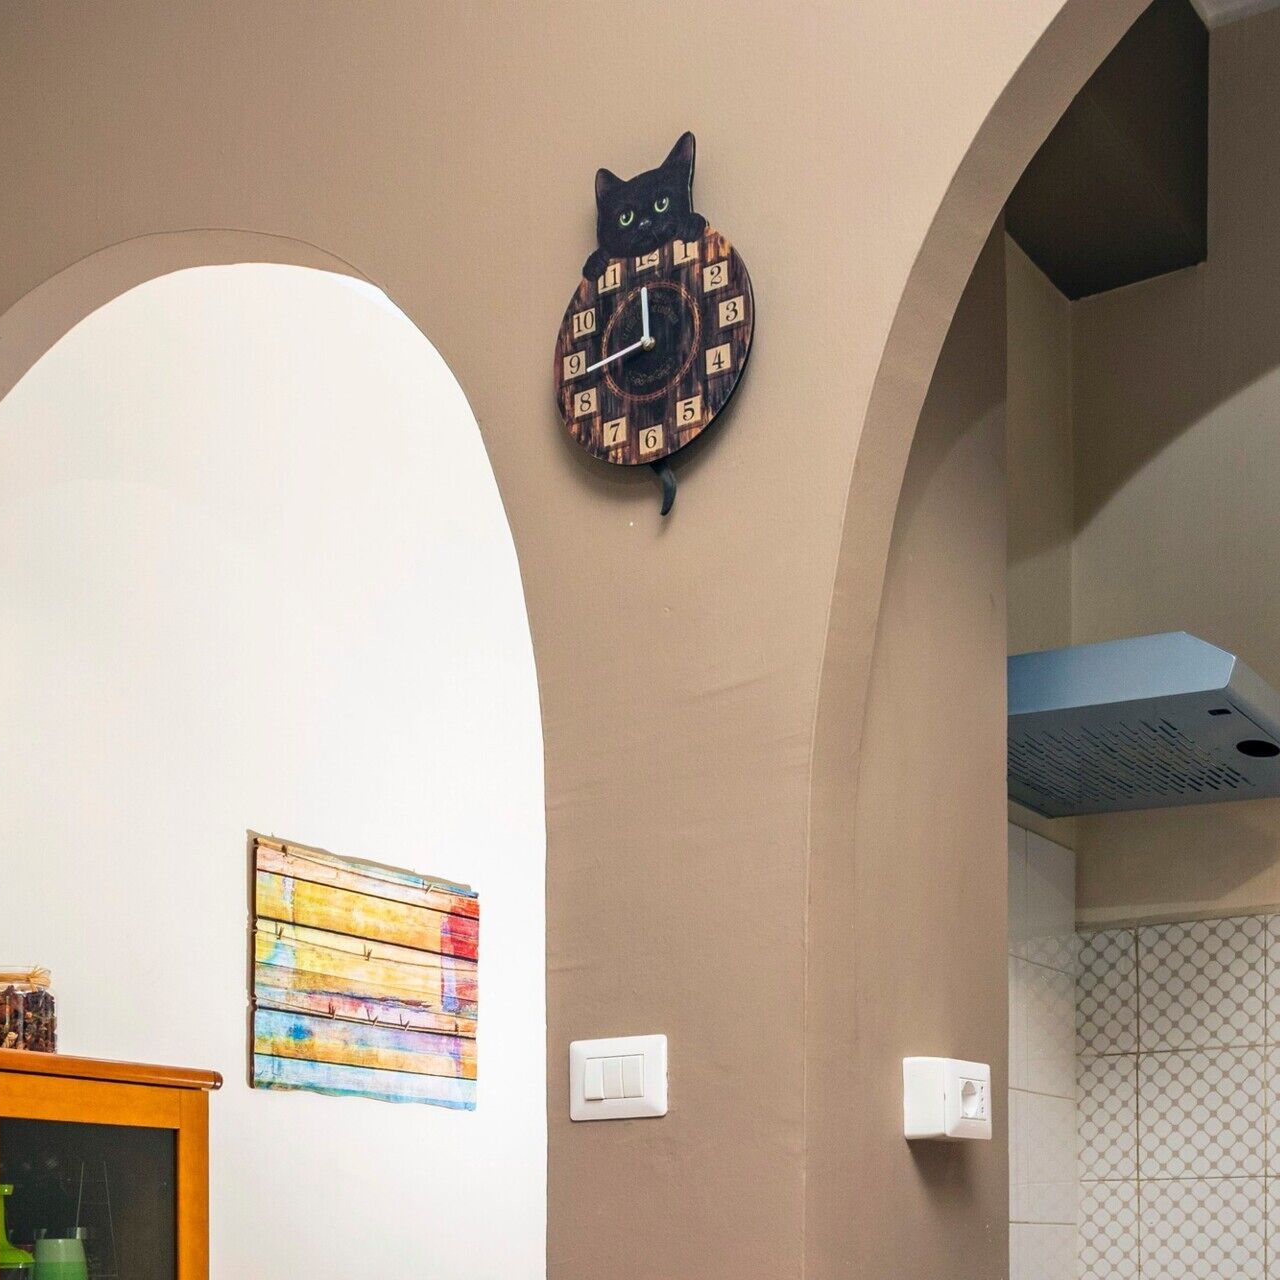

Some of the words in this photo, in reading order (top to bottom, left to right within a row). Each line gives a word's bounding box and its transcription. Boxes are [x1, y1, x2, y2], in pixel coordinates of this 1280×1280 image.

[601, 268, 618, 289] 11
[710, 265, 722, 286] 2
[726, 301, 738, 322] 3
[575, 311, 594, 333] 10
[569, 355, 581, 374] 9
[712, 348, 725, 370] 4
[580, 392, 592, 412] 8
[682, 401, 695, 421] 5
[609, 423, 620, 442] 7
[645, 429, 657, 449] 6
